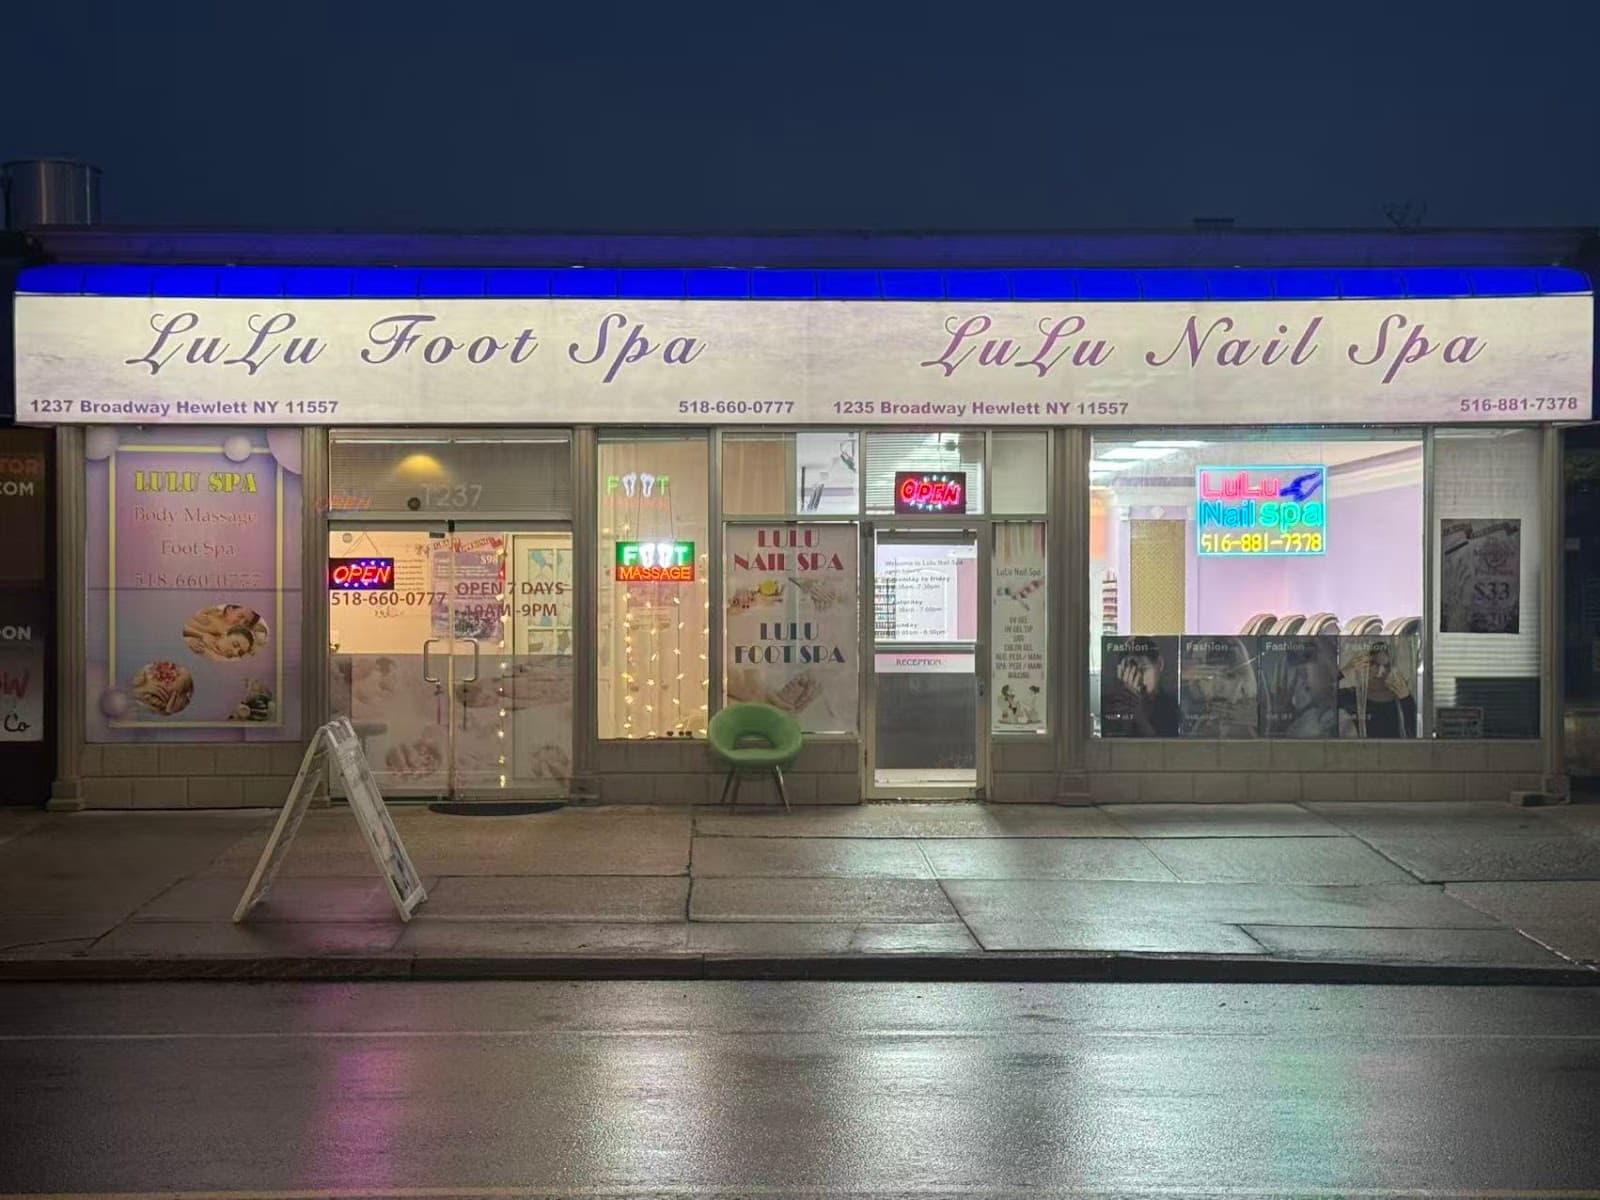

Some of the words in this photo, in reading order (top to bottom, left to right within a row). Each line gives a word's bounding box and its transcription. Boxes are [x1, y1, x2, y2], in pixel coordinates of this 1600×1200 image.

[124, 312, 327, 375] LuLu
[361, 315, 539, 364] Foot
[568, 313, 706, 383] Spa
[920, 315, 1115, 377] LuLu
[1145, 316, 1323, 368] Nail
[1348, 314, 1487, 384] Spa
[30, 400, 73, 413] 1237
[80, 401, 170, 416] Broadway
[177, 401, 247, 414] Hewlett
[254, 401, 278, 414] NY
[285, 401, 338, 414] 11557
[679, 401, 795, 414] 518-660-0777
[833, 401, 874, 414] 1235
[880, 402, 966, 417] Broadway
[972, 402, 1040, 415] Hewlett
[1046, 402, 1070, 415] NY
[1077, 402, 1129, 415] 11557
[1460, 397, 1577, 412] 516-881-7378
[0, 481, 34, 496] OM
[135, 471, 200, 492] LULU
[208, 472, 257, 494] SPA
[901, 478, 961, 505] OPEN
[1201, 470, 1280, 499] LuLu
[135, 505, 177, 527] Body
[185, 507, 256, 527] Massage
[1200, 500, 1256, 528] Nail
[758, 530, 820, 548] LULU
[1202, 532, 1322, 553] 516-881-7378
[162, 540, 201, 555] Foot
[203, 542, 235, 559] Spa
[734, 553, 791, 571] NAIL
[797, 552, 844, 571] SPA
[333, 566, 390, 583] OPEN
[620, 566, 691, 580] MASSAGE
[457, 582, 502, 596] OPEN
[507, 582, 516, 595] 7
[521, 582, 564, 595] DAYS
[331, 592, 448, 606] 518-660-0777
[760, 622, 819, 640] LULU
[735, 645, 796, 664] FOOT
[799, 645, 845, 664] SPA
[1106, 642, 1149, 652] Fashion
[1186, 642, 1228, 652] Fashion
[1265, 641, 1305, 652] Fashion
